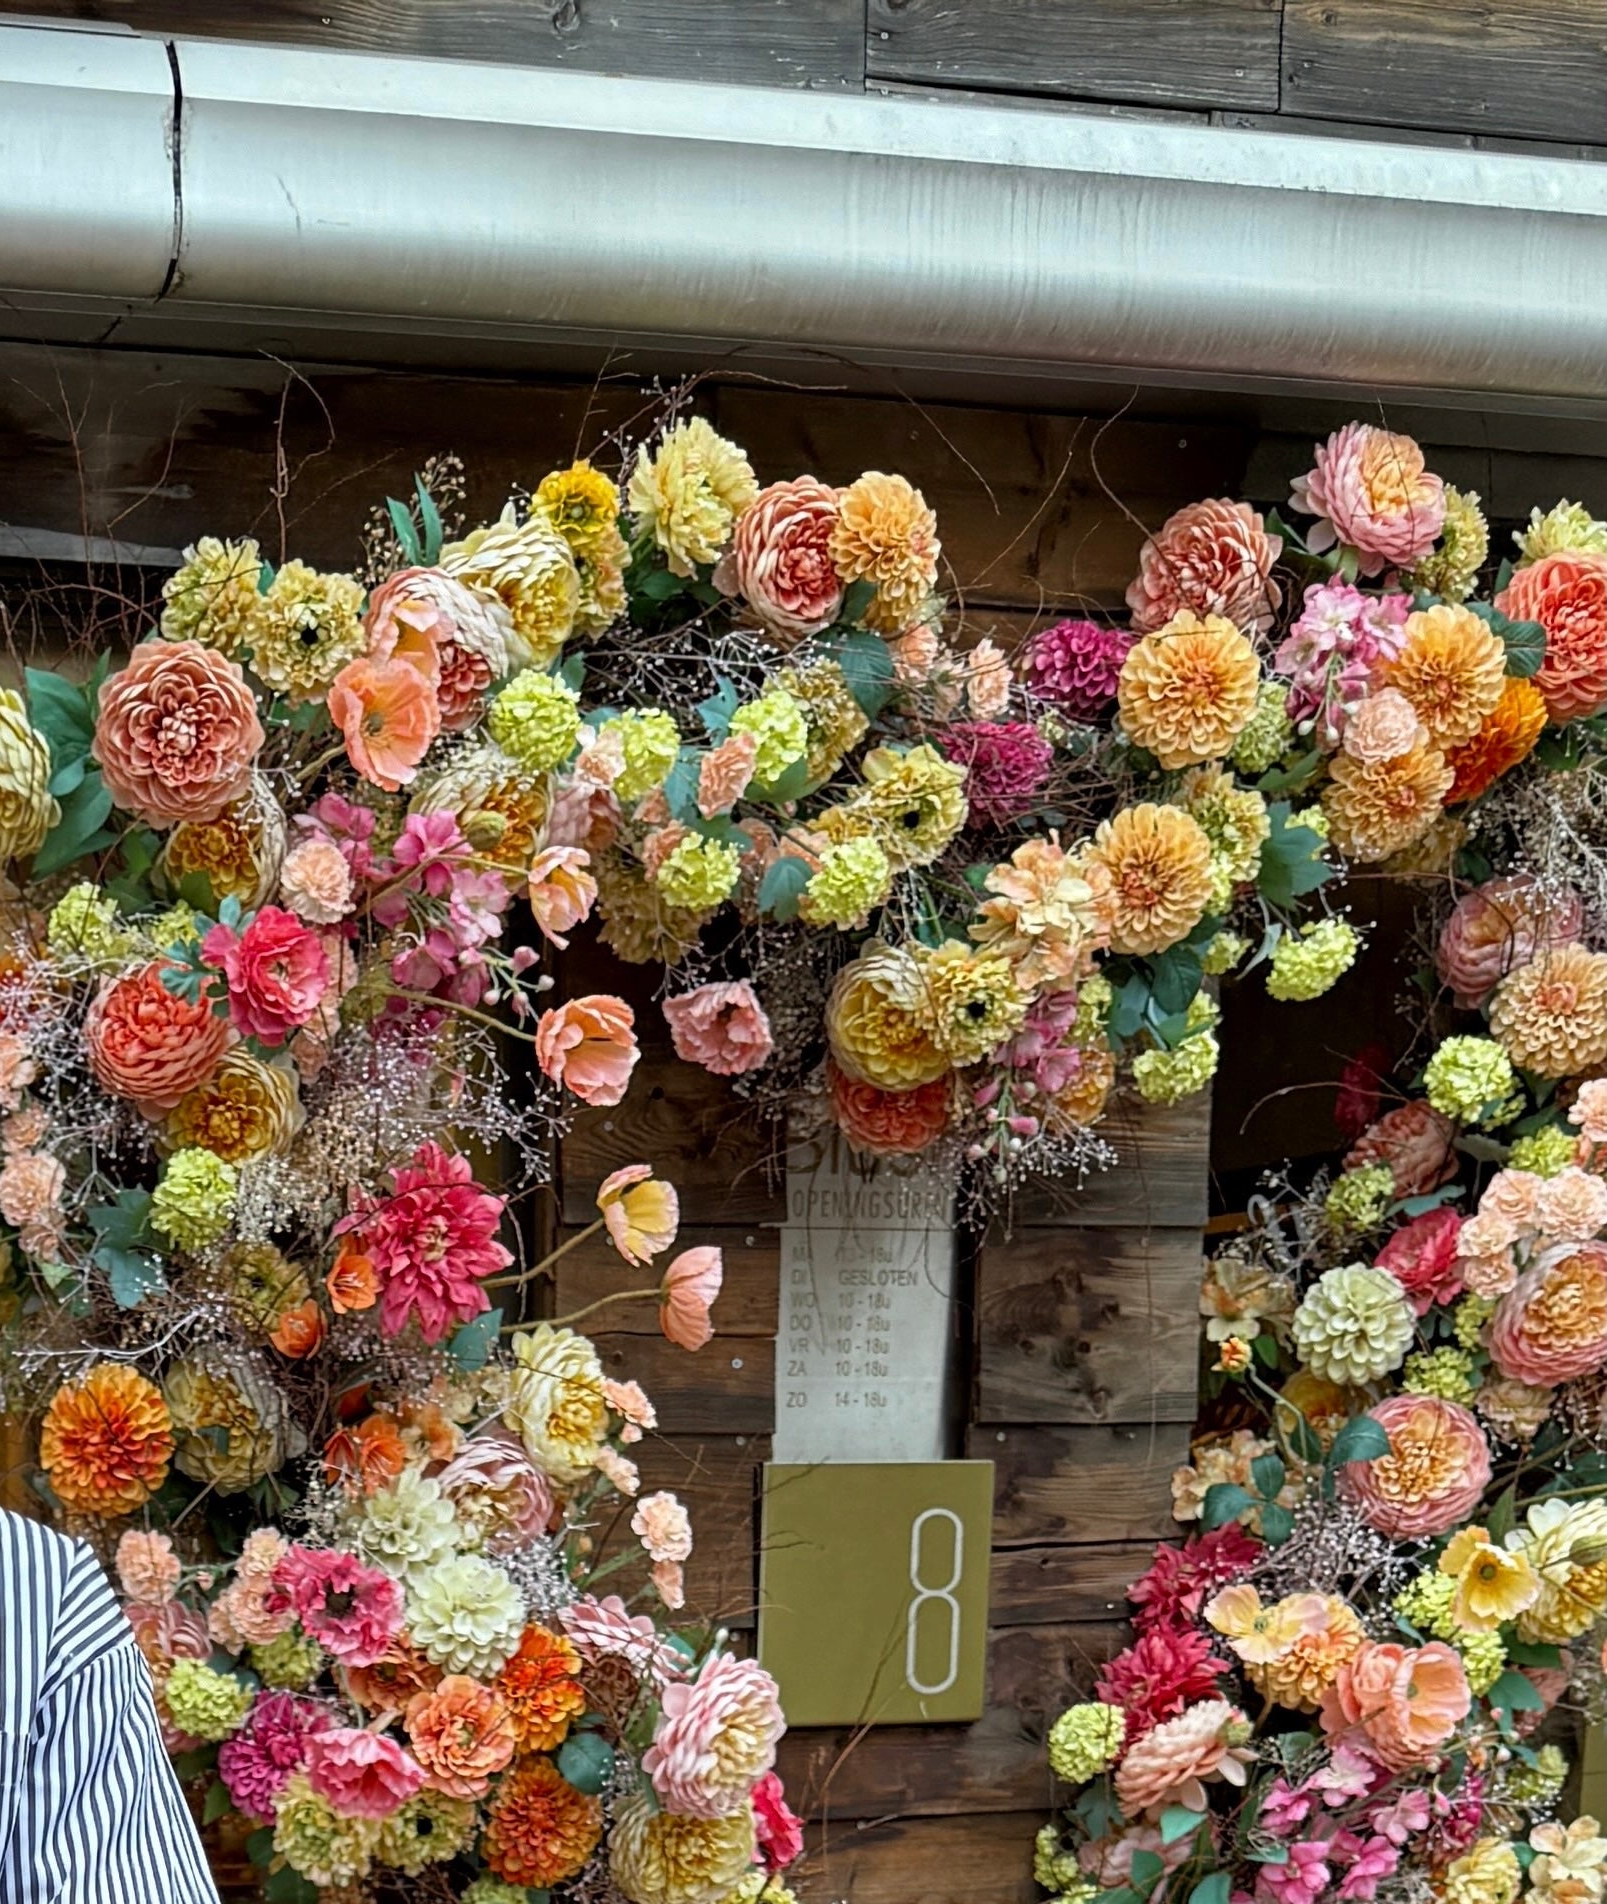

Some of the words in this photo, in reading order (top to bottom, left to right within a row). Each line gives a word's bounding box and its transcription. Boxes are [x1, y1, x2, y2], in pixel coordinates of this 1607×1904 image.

[837, 1269, 919, 1287] GESLOTEN
[789, 1292, 817, 1309] WO
[838, 1292, 855, 1309] 10
[868, 1292, 892, 1310] 18u
[789, 1314, 813, 1332] DO
[837, 1314, 853, 1332] 10
[866, 1314, 891, 1332] 18u
[788, 1337, 810, 1353] VR
[835, 1337, 852, 1355] 10
[865, 1337, 890, 1355] 18u
[786, 1360, 808, 1377] ZA
[835, 1360, 851, 1377] 10
[864, 1360, 889, 1377] 18u
[785, 1391, 808, 1409] ZO
[863, 1391, 889, 1409] 18u
[905, 1507, 964, 1695] 8
